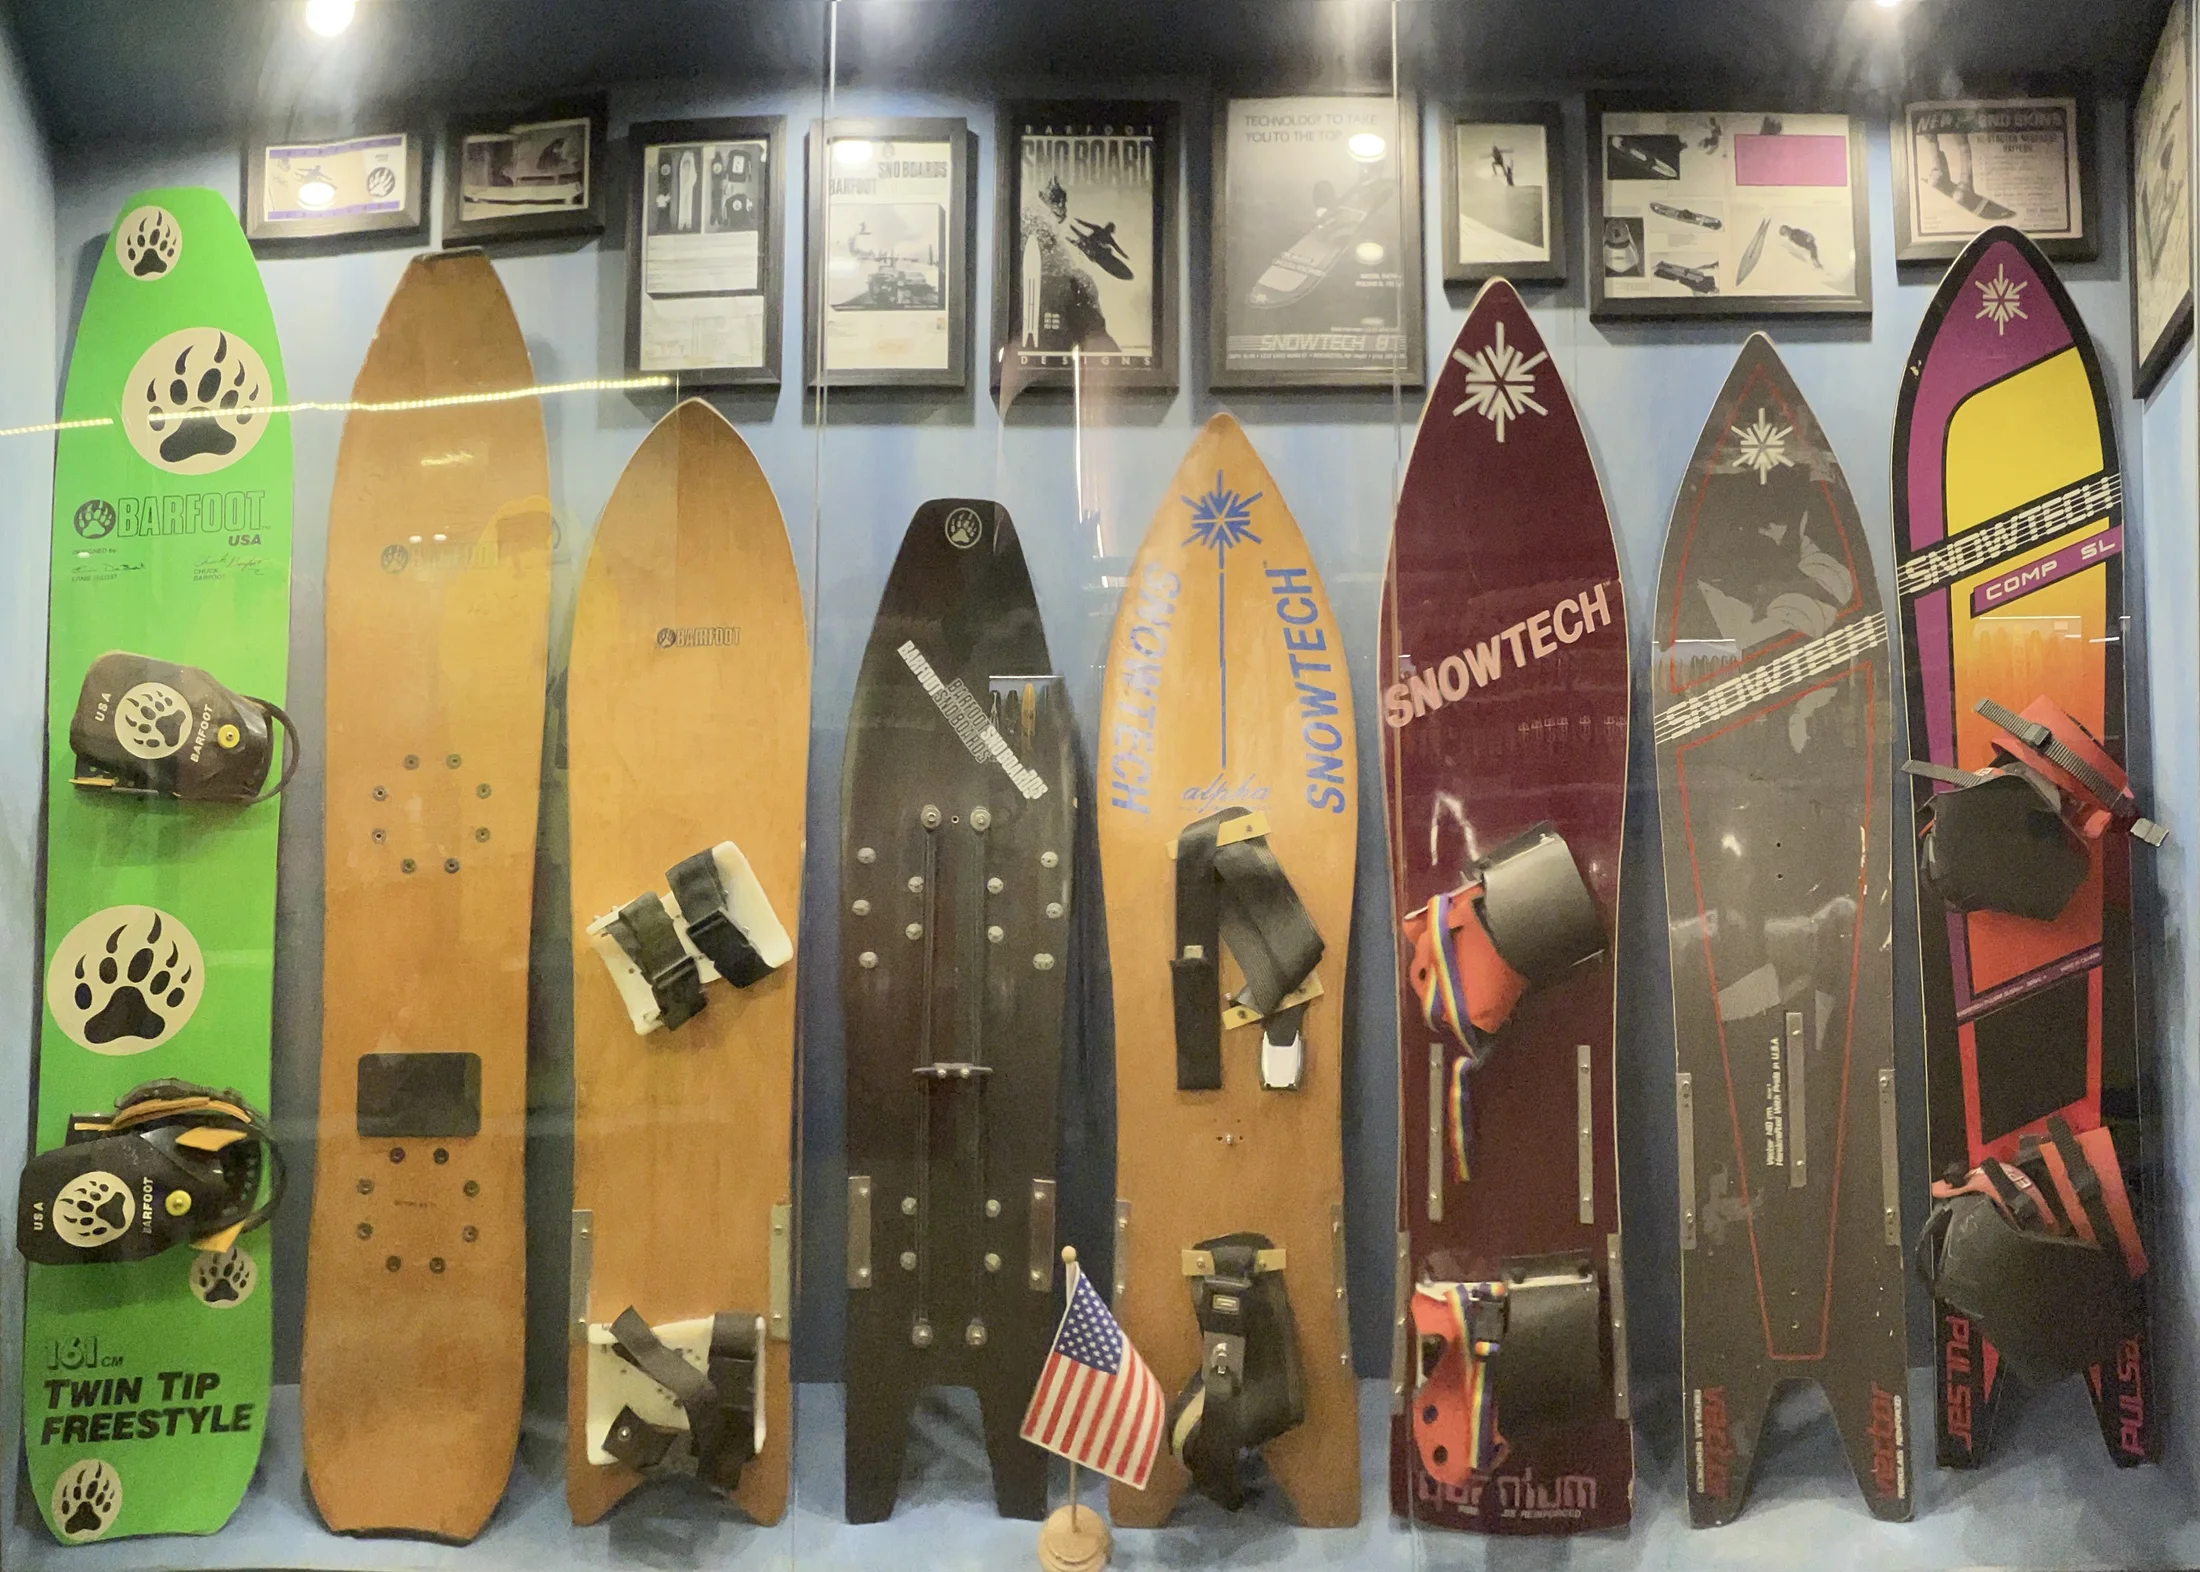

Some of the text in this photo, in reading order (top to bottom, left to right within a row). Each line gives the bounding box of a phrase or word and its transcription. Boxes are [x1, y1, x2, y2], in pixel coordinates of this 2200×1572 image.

[1025, 124, 1153, 136] BARFOOT
[1245, 114, 1377, 127] TECHNOLOGY TO TAKE
[1246, 130, 1342, 143] YOU TO THE TOP
[1020, 356, 1151, 365] DESIGNS
[1260, 334, 1365, 351] SNOWTECH
[117, 490, 265, 537] BARFOOT
[228, 534, 262, 546] USA
[1905, 476, 2113, 594] SNOWTECH
[1986, 539, 2116, 600] COMP SL
[676, 627, 741, 647] BARFOOT
[1384, 583, 1611, 728] SNOWTECH
[896, 639, 946, 697] BARFOOT
[1112, 561, 1182, 814] SNOWTECH
[1666, 616, 1878, 739] SNOWTECH
[95, 692, 112, 722] USA
[945, 677, 993, 734] BARFOOT
[1265, 567, 1346, 814] SNOWTECH
[190, 704, 214, 763] BARFOOT
[1181, 773, 1273, 813] alpha
[33, 1201, 44, 1231] USA
[46, 1336, 124, 1370] 161 CM
[44, 1371, 221, 1410] TWIN TIP
[40, 1403, 256, 1446] FREESTYLE
